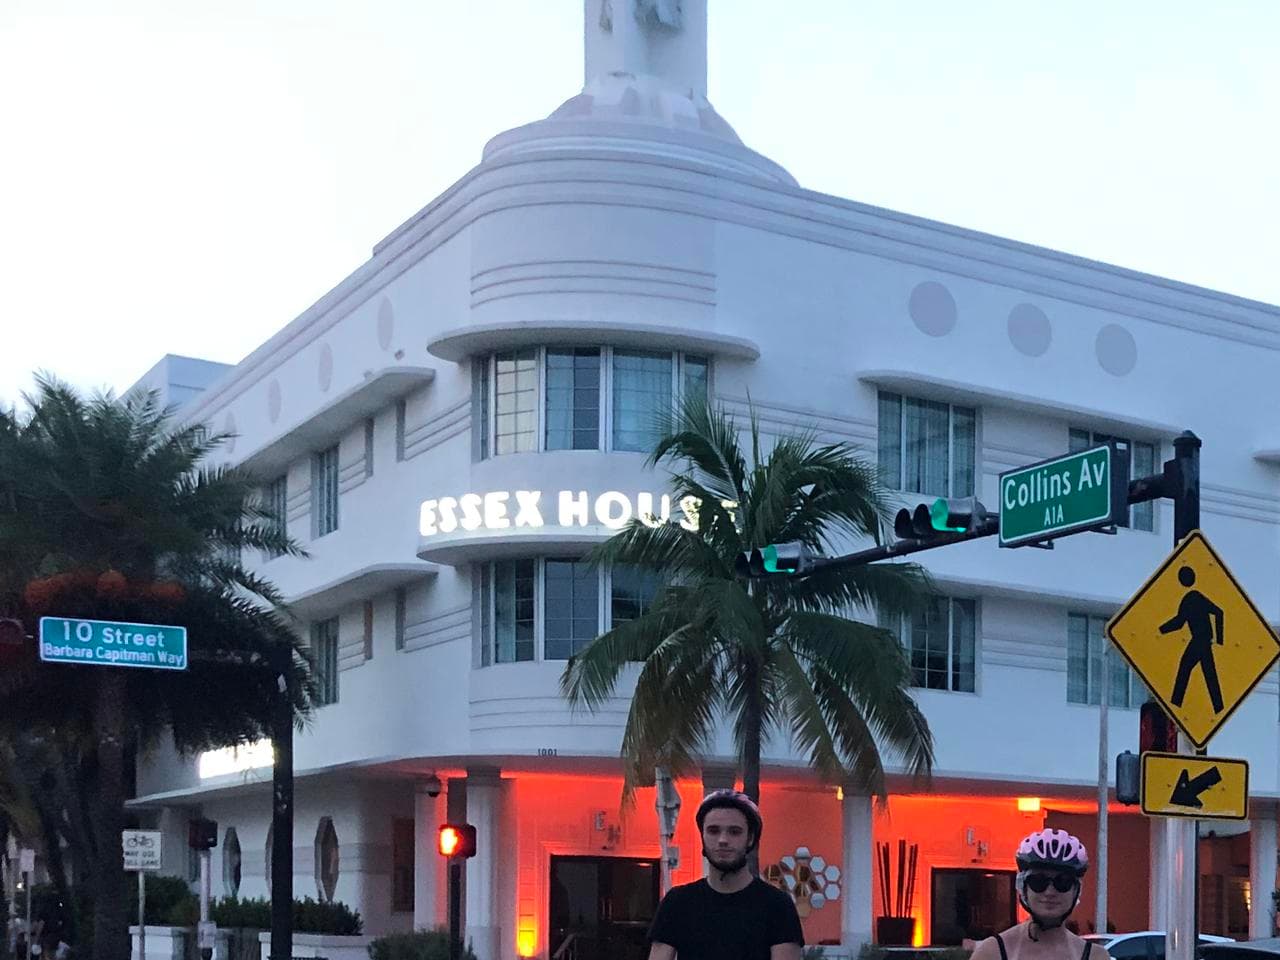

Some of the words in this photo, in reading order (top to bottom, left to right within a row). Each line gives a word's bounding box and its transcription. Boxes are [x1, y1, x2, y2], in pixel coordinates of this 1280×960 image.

[1004, 469, 1071, 510] Collins
[1077, 458, 1105, 491] Av
[419, 490, 544, 536] ESSEX
[558, 490, 741, 532] HOUS
[1043, 503, 1064, 526] A1A
[63, 621, 93, 642] 10
[102, 627, 165, 648] Street
[44, 643, 93, 658] Barbara
[96, 646, 155, 663] Capitman
[157, 651, 183, 666] Way
